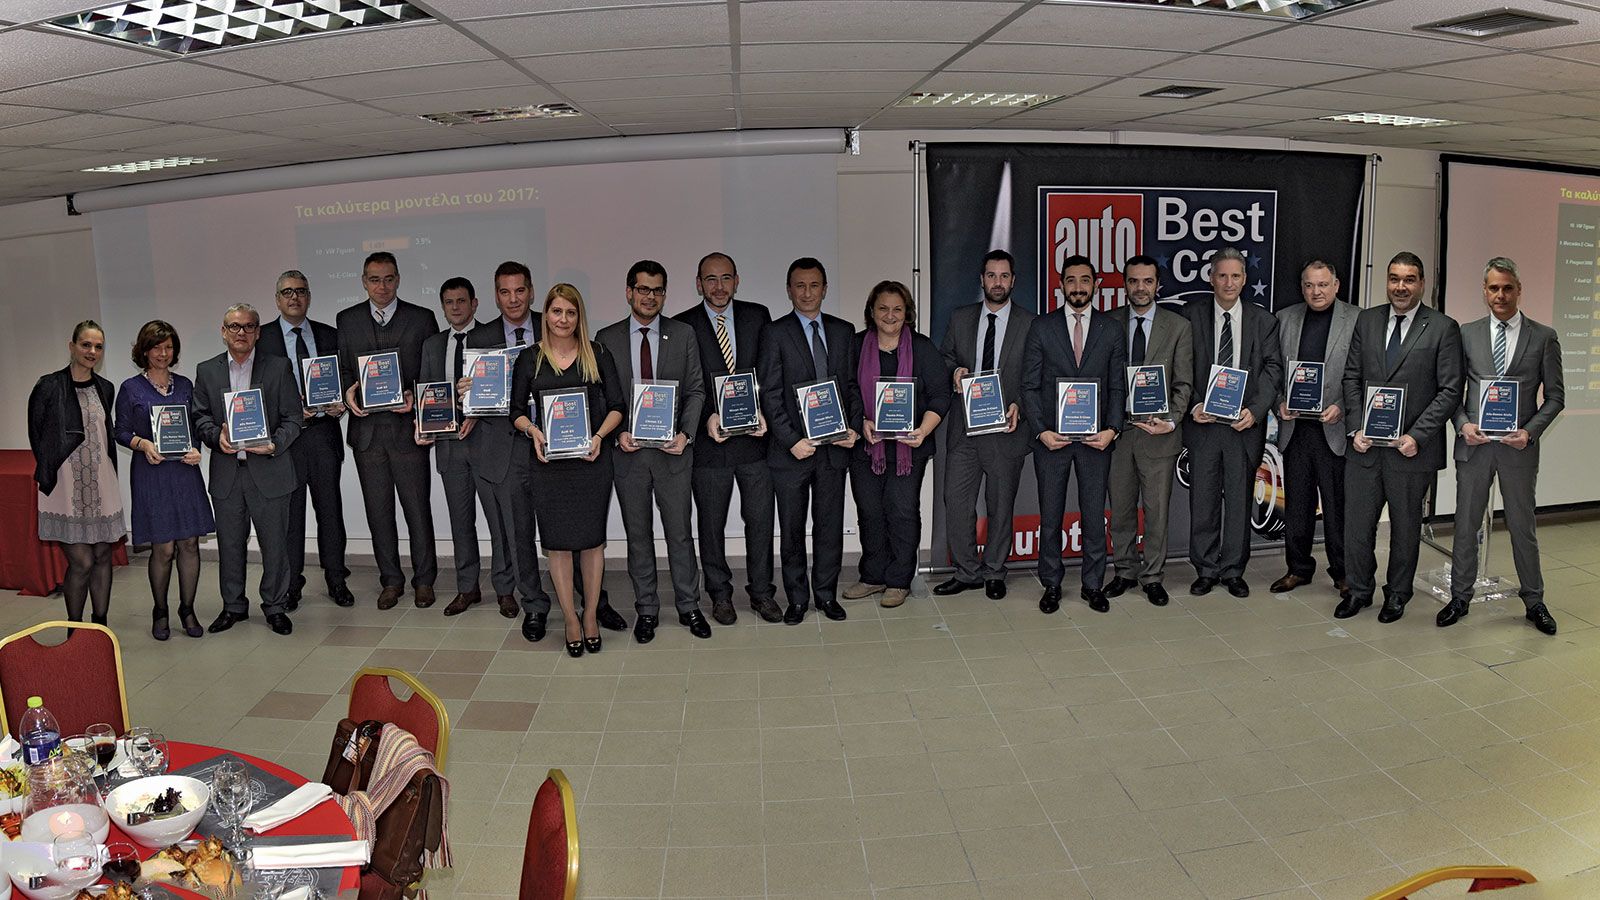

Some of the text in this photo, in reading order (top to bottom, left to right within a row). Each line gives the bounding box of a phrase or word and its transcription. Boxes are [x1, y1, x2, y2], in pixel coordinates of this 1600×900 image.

[294, 187, 541, 219] Τα καλύτερα μοντέλα του 2017:
[1560, 188, 1572, 199] Τα
[1055, 204, 1137, 274] auto
[1157, 196, 1265, 243] Best
